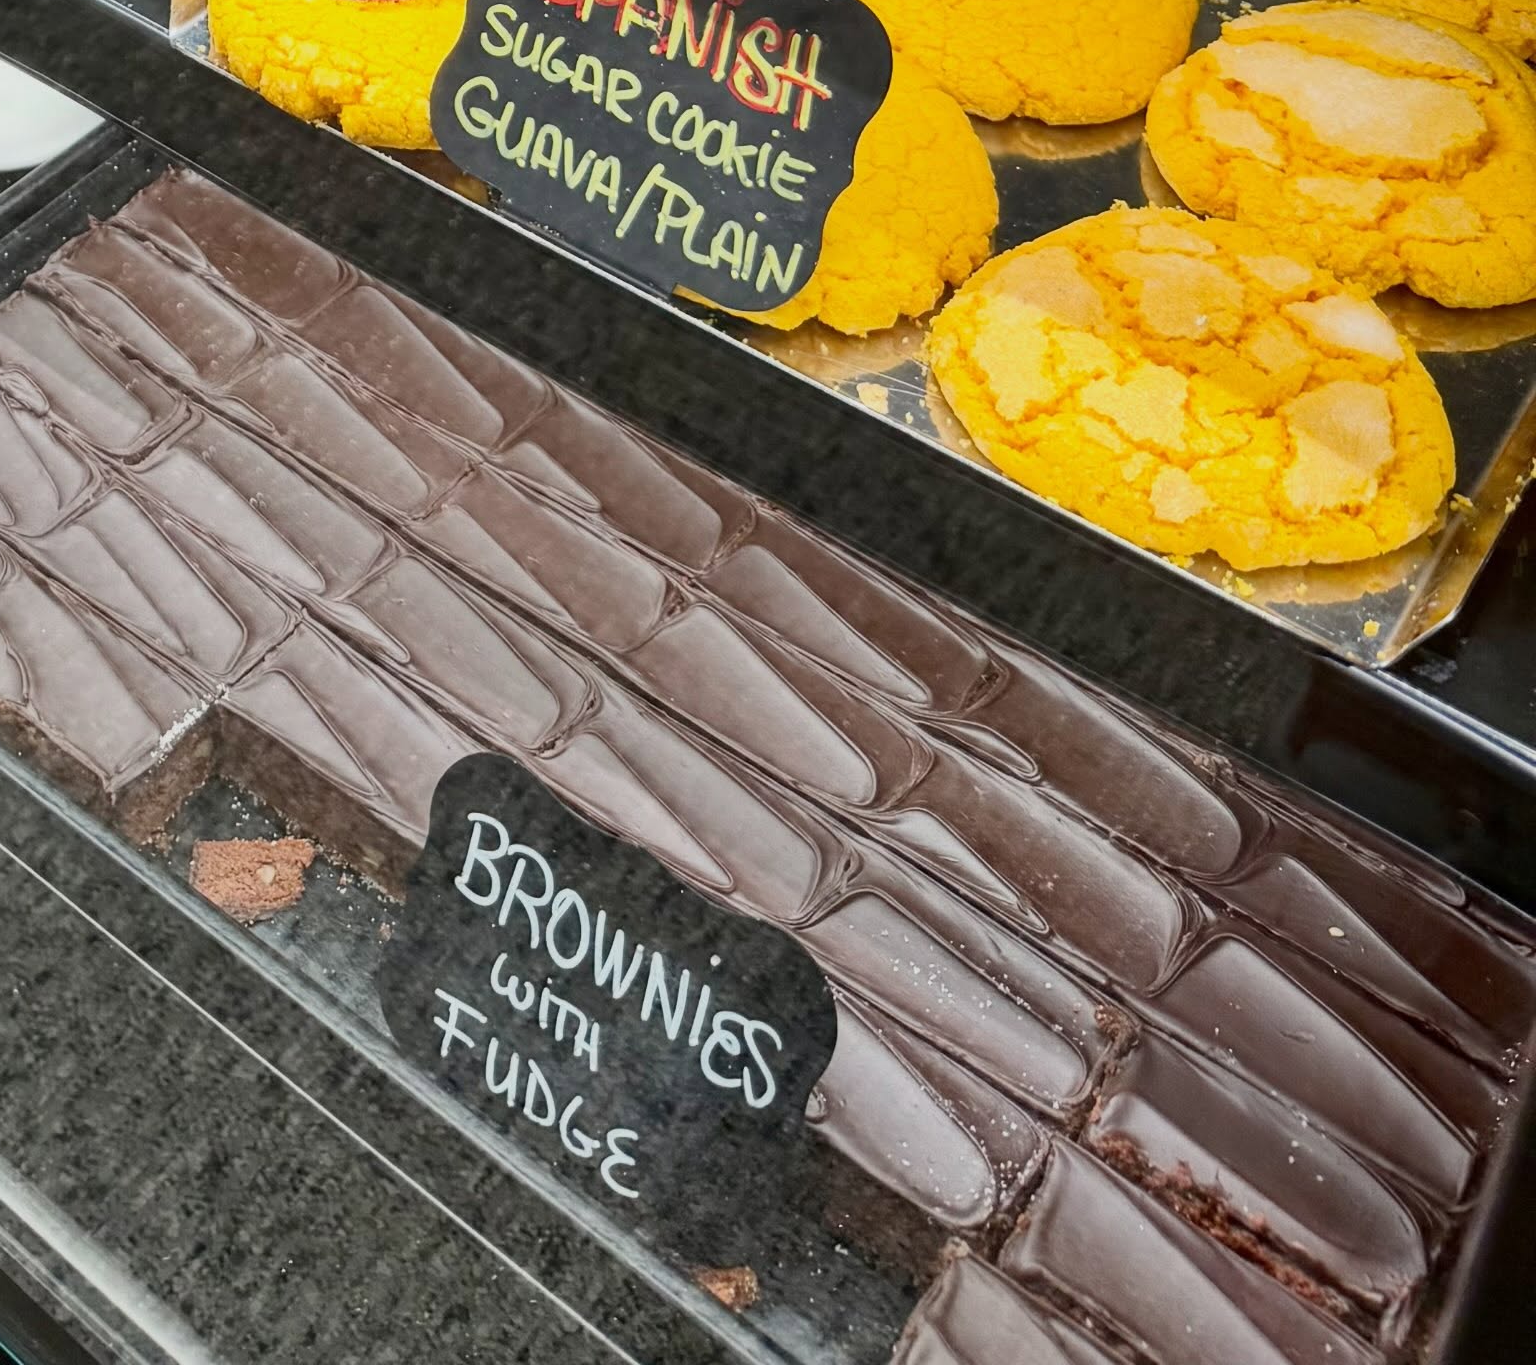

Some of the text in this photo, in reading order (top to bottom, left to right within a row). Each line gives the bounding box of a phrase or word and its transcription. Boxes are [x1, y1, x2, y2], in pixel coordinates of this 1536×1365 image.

[480, 4, 816, 201] SUGAR COOKIE
[455, 812, 782, 1109] BROWNIES
[434, 989, 640, 1198] FUDGE
